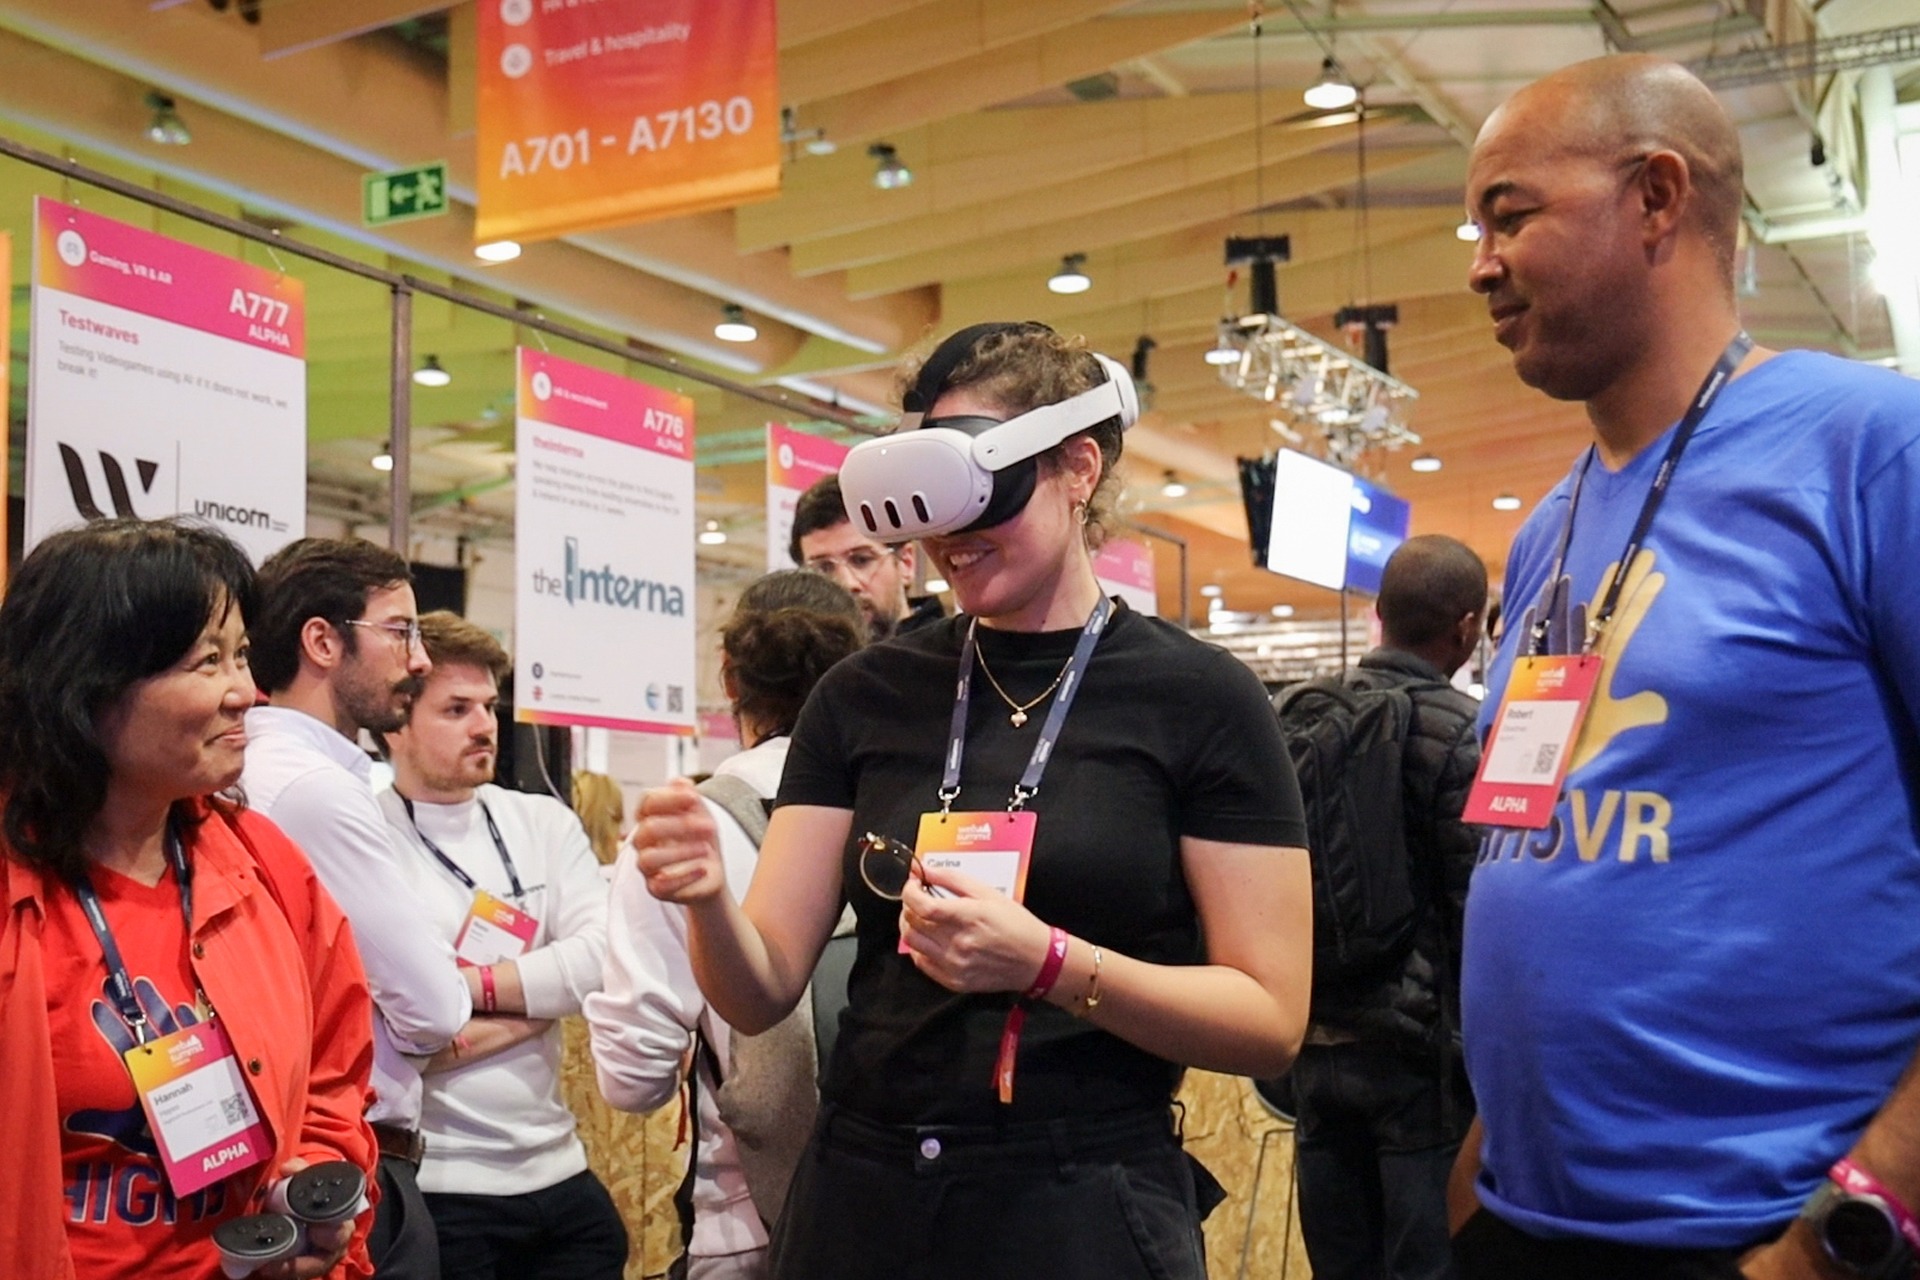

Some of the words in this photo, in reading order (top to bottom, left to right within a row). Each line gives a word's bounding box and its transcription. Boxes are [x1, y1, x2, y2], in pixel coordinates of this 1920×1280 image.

[590, 37, 602, 55] &
[501, 129, 590, 179] A701
[601, 136, 616, 147] -
[628, 96, 753, 155] A7130
[230, 288, 289, 327] A777
[59, 310, 139, 345] Testwaves
[248, 324, 290, 348] ALPHA
[643, 408, 683, 438] A776
[195, 499, 269, 529] unicorn
[1488, 796, 1528, 813] ALPHA
[927, 859, 961, 868] Carina
[154, 1083, 193, 1106] Hannah
[203, 1142, 249, 1172] ALPHA
